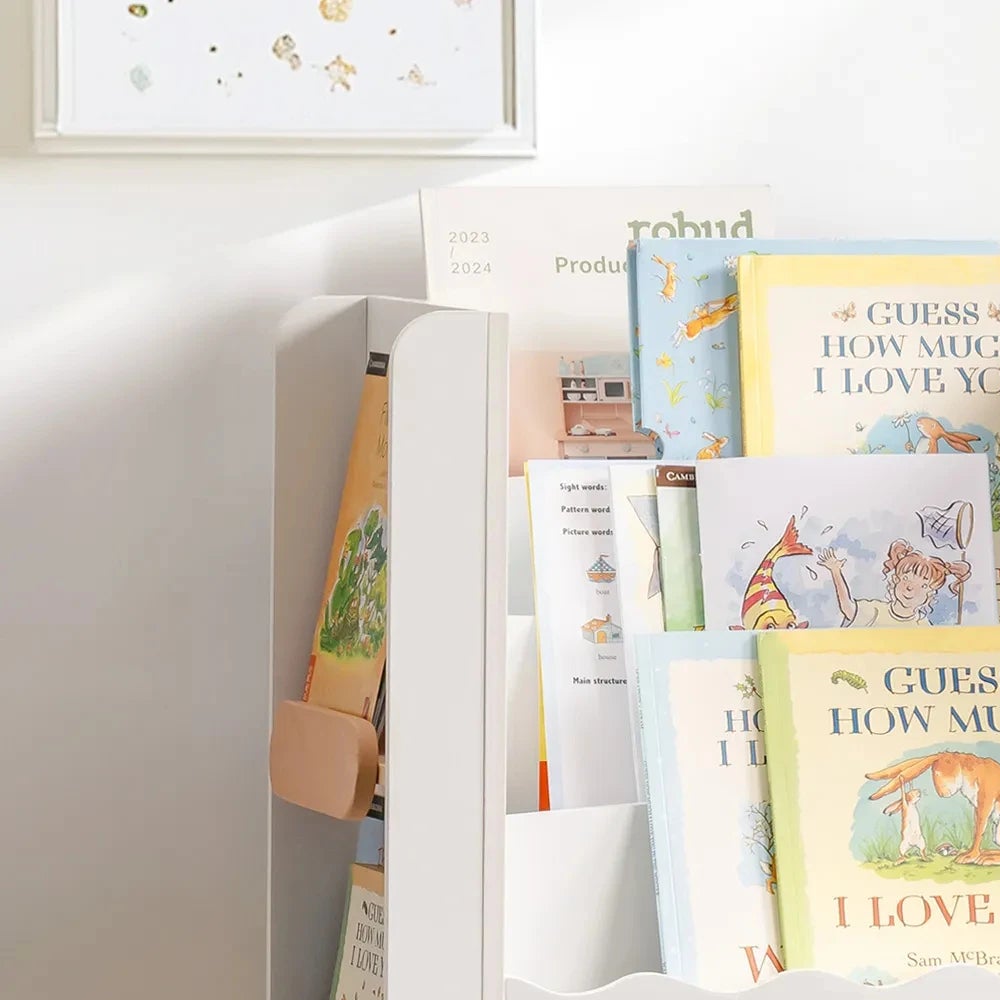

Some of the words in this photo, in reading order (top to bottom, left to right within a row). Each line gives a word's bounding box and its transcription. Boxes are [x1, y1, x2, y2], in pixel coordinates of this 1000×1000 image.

[627, 209, 754, 239] robud
[448, 231, 490, 244] 2023
[451, 261, 492, 275] 2024
[867, 301, 980, 326] GUESS
[820, 335, 908, 359] HOW
[813, 367, 827, 394] I
[840, 366, 946, 395] LOVE
[560, 482, 579, 492] Sight
[582, 483, 608, 491] words:
[561, 505, 589, 513] Pattern
[591, 505, 610, 513] word
[563, 528, 589, 536] Picture
[572, 676, 591, 685] Main
[593, 677, 628, 685] structure
[828, 705, 936, 735] HOW
[834, 895, 851, 929] I
[868, 894, 995, 929] LOVE
[356, 947, 380, 977] LOVE
[907, 952, 942, 967] Sam
